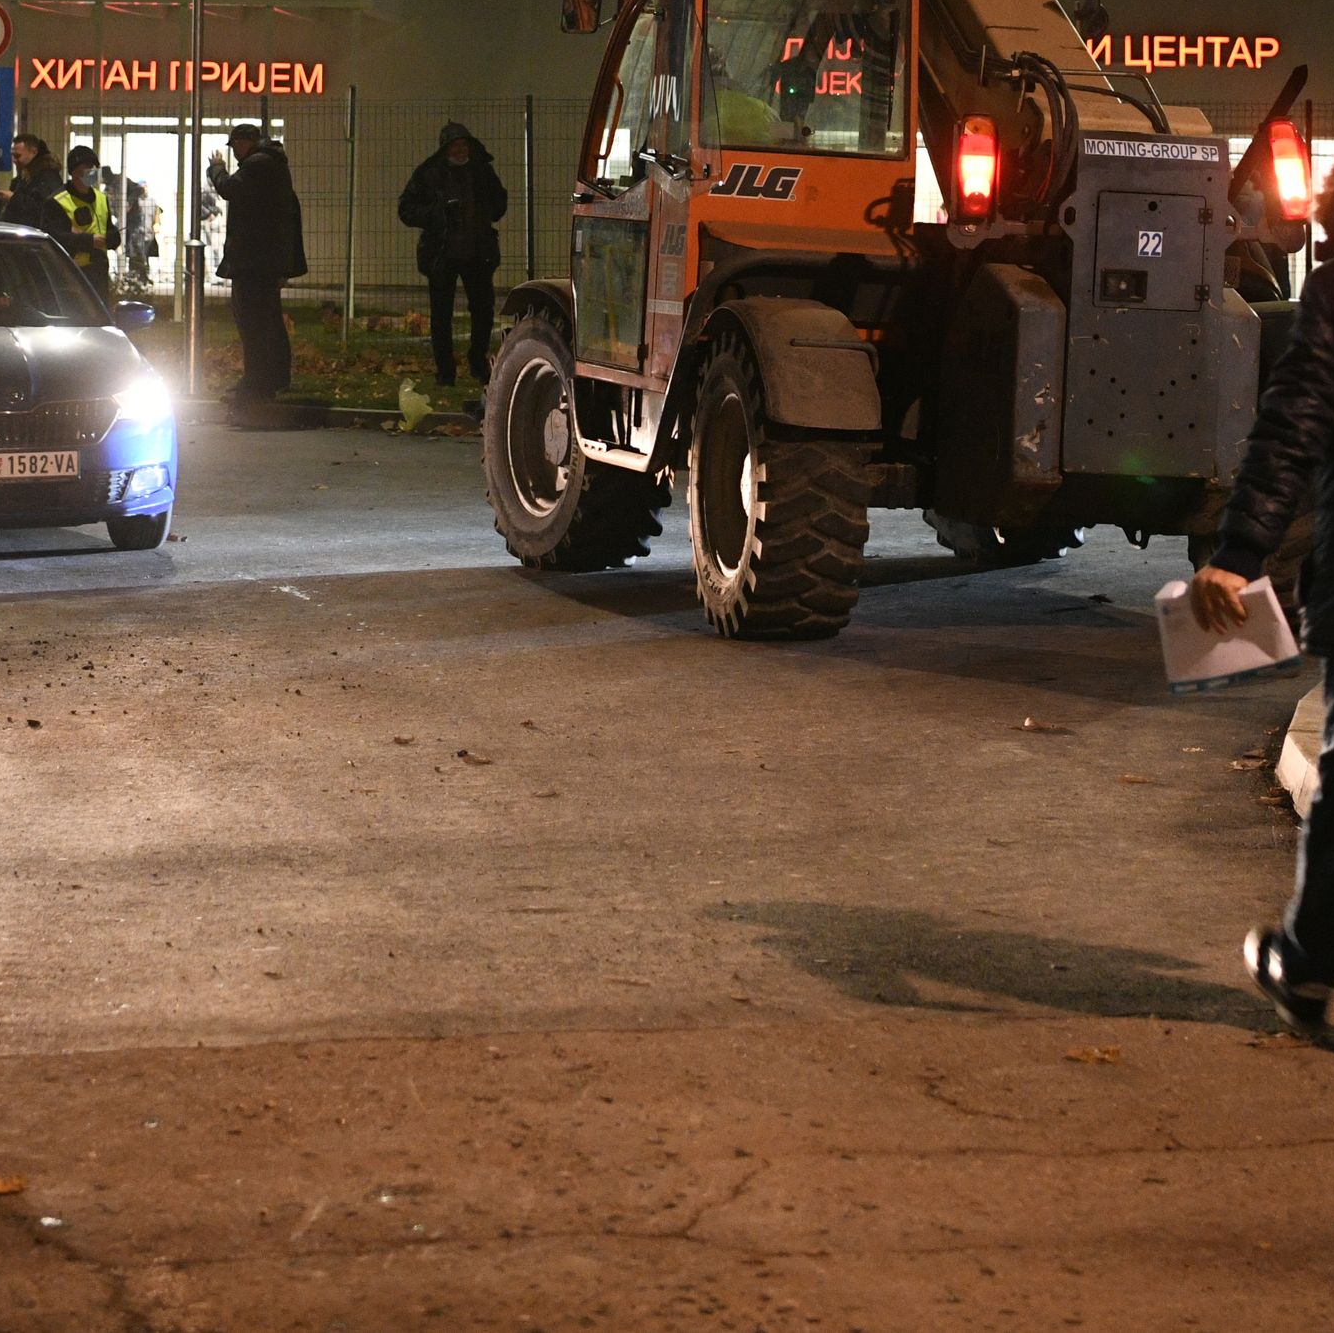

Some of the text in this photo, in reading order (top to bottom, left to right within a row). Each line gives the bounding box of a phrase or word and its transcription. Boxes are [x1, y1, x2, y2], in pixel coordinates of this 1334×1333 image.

[1125, 35, 1280, 73] ЦЕНТАР
[169, 60, 323, 94] ПРИЈЕМ
[1086, 140, 1217, 160] MONTING-GROUP SP
[709, 163, 803, 202] JLG
[1139, 233, 1162, 256] 22
